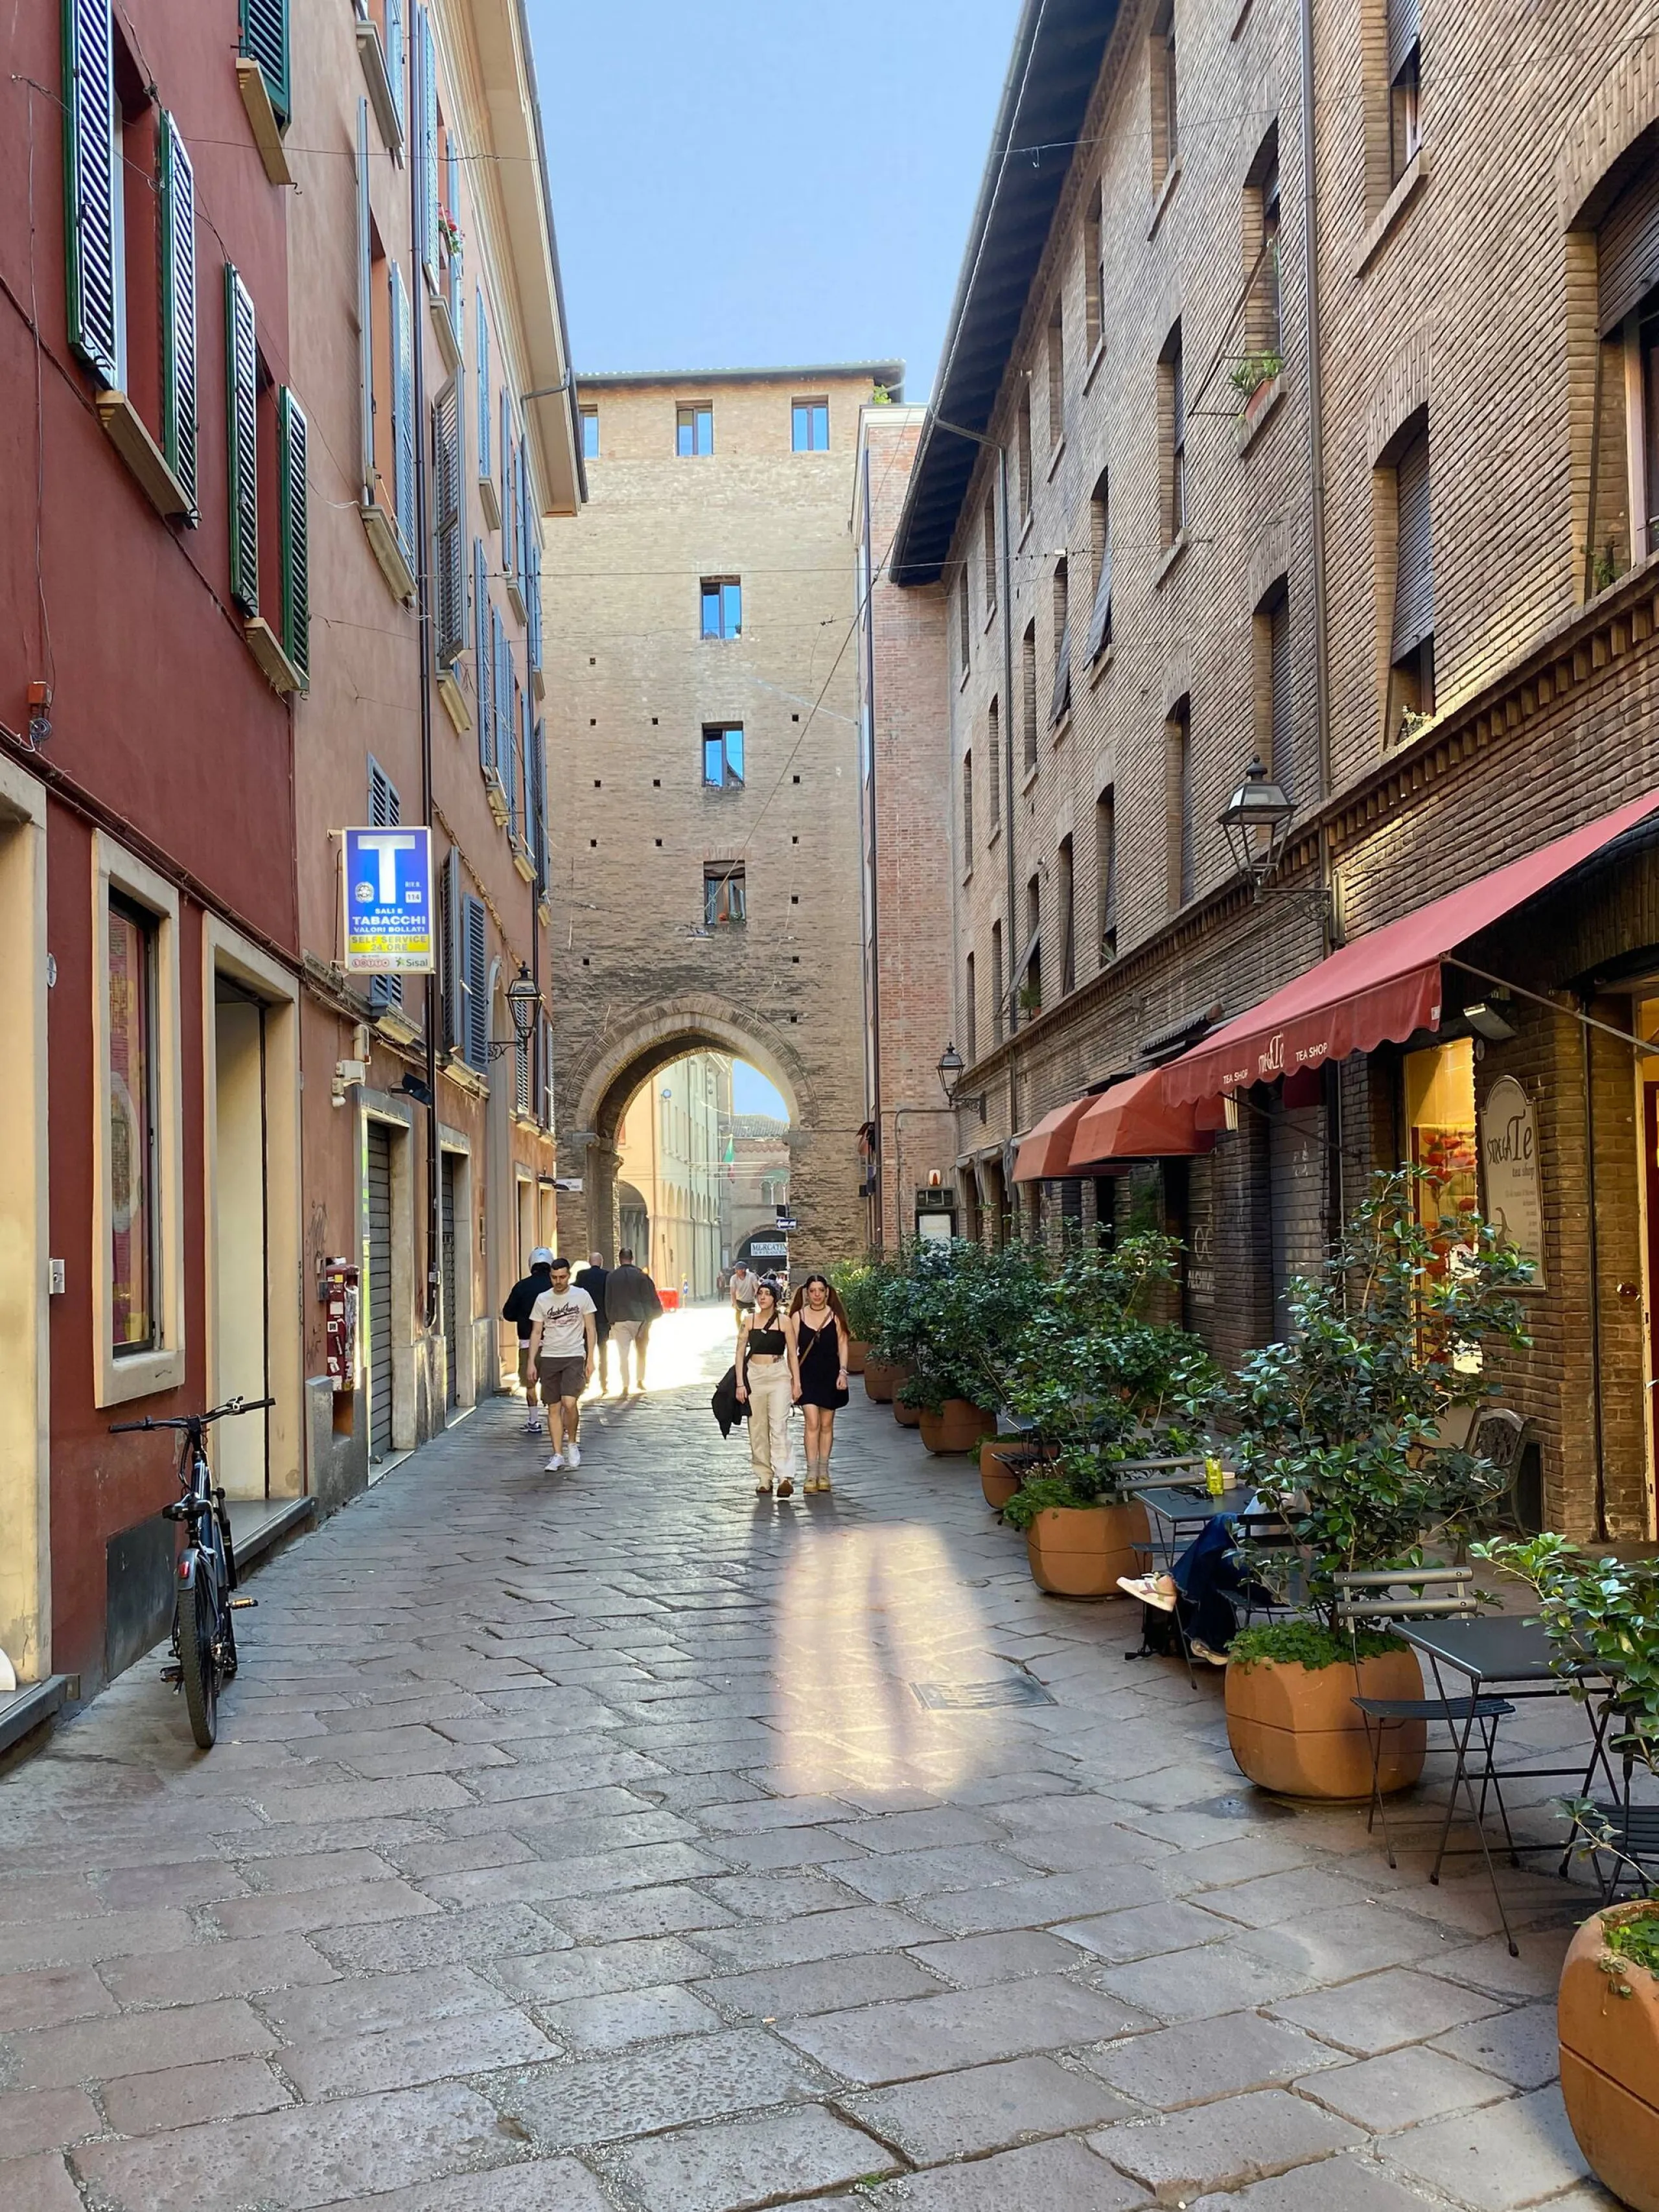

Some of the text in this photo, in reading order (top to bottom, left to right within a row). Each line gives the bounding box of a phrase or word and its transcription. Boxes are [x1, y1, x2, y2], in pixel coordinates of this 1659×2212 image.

[358, 835, 415, 904] T
[352, 916, 426, 925] TABACCHI
[406, 958, 428, 967] Sisal
[1295, 1042, 1328, 1062] TEA SHOP
[1223, 1068, 1248, 1085] TEA SHOP
